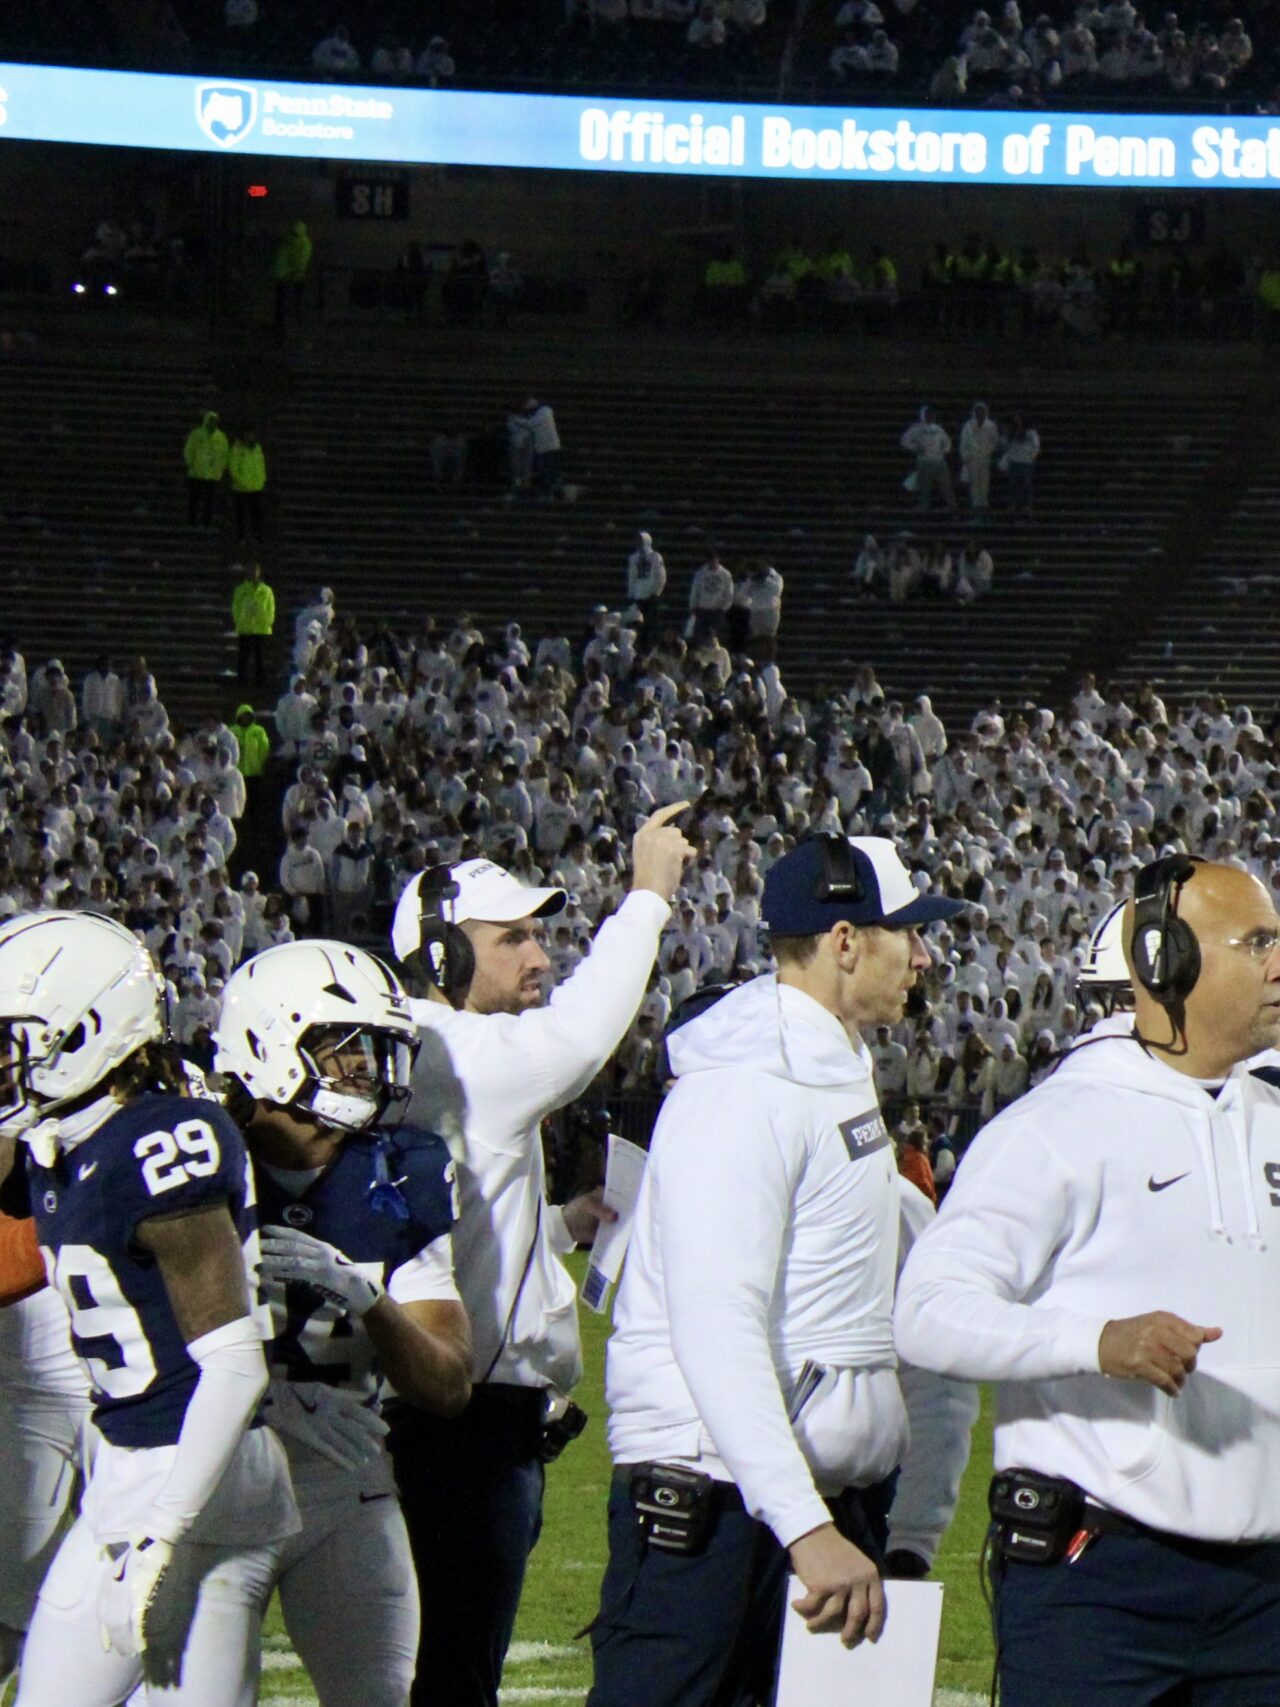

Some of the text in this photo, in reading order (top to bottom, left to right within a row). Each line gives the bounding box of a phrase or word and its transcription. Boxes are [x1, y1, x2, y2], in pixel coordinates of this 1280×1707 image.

[263, 119, 353, 140] Bookstore
[579, 108, 744, 166] Official
[761, 115, 986, 173] Bookstore
[1002, 123, 1051, 174] of
[1065, 124, 1175, 177] Penn
[352, 185, 394, 215] SH
[468, 863, 495, 879] PENN
[133, 1119, 220, 1196] 29
[39, 1244, 158, 1399] 9
